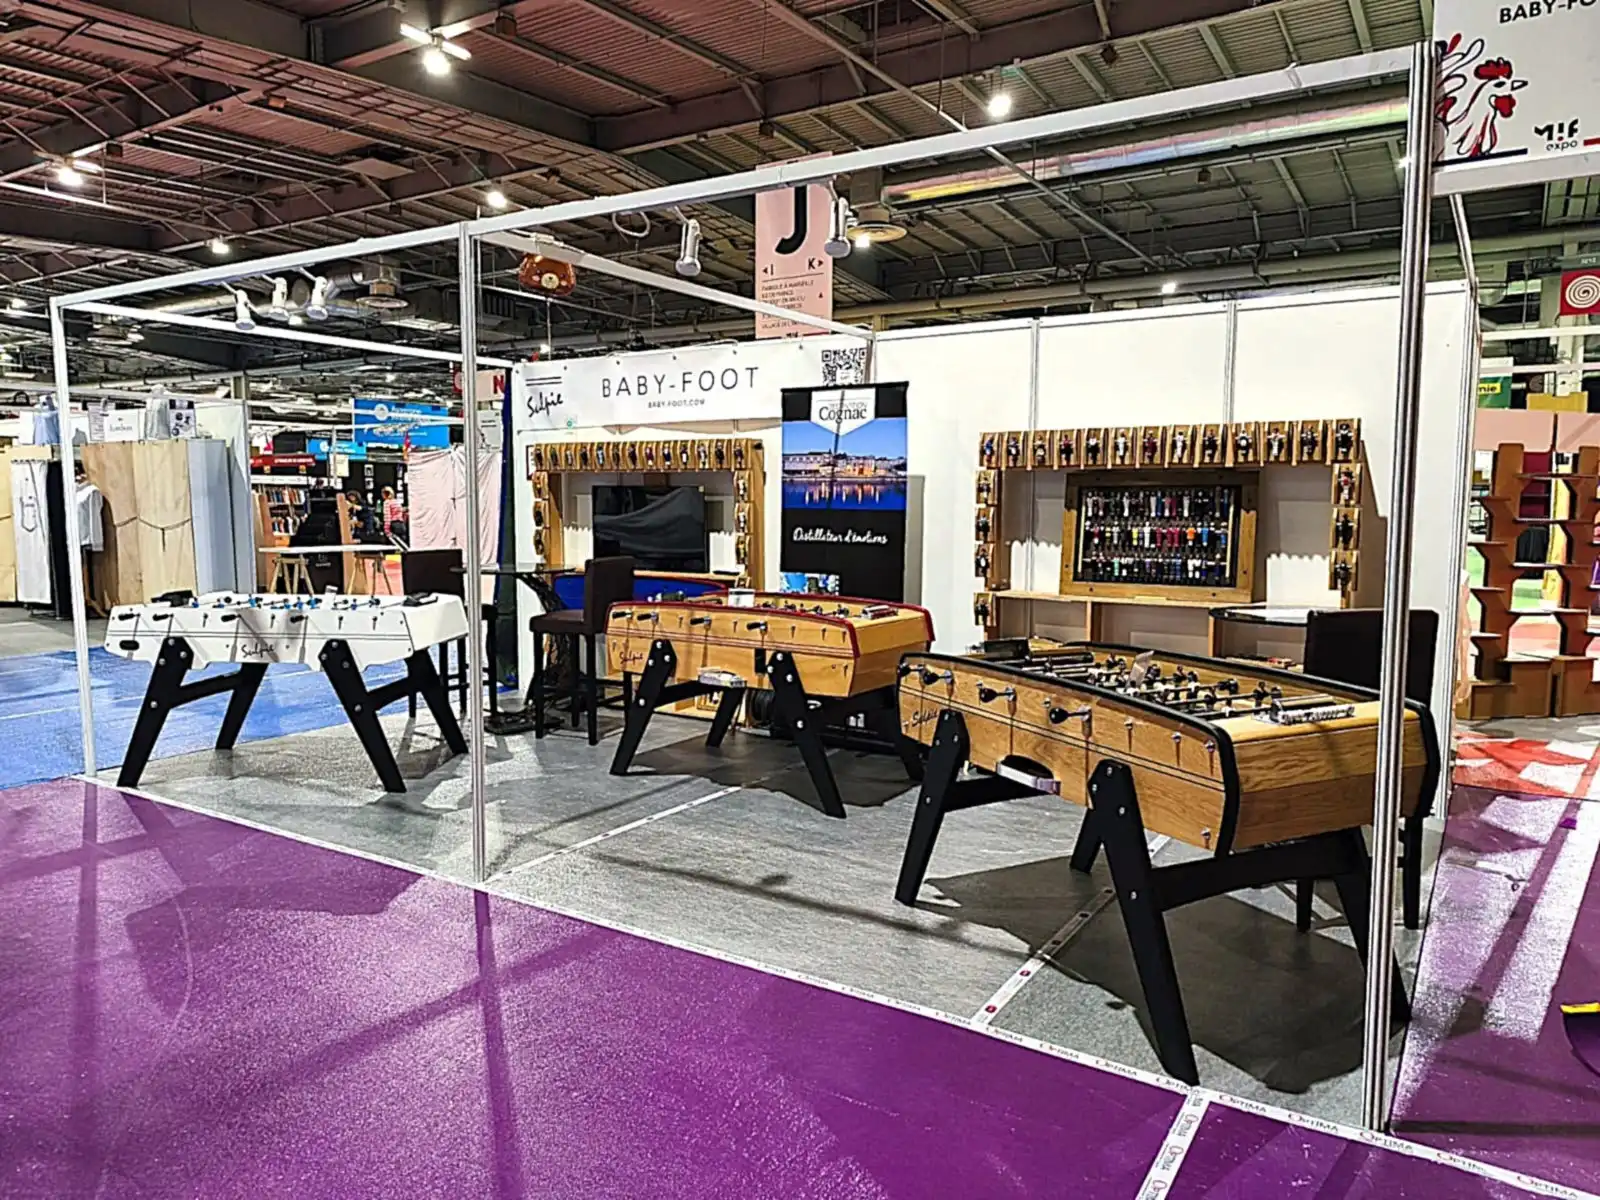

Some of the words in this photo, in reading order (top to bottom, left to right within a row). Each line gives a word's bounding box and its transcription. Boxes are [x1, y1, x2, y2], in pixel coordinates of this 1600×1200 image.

[1546, 140, 1578, 151] expo
[775, 184, 807, 255] J
[808, 257, 816, 270] K
[493, 374, 505, 394] N
[602, 366, 759, 397] BABY-FOOT
[819, 406, 867, 425] Cognac
